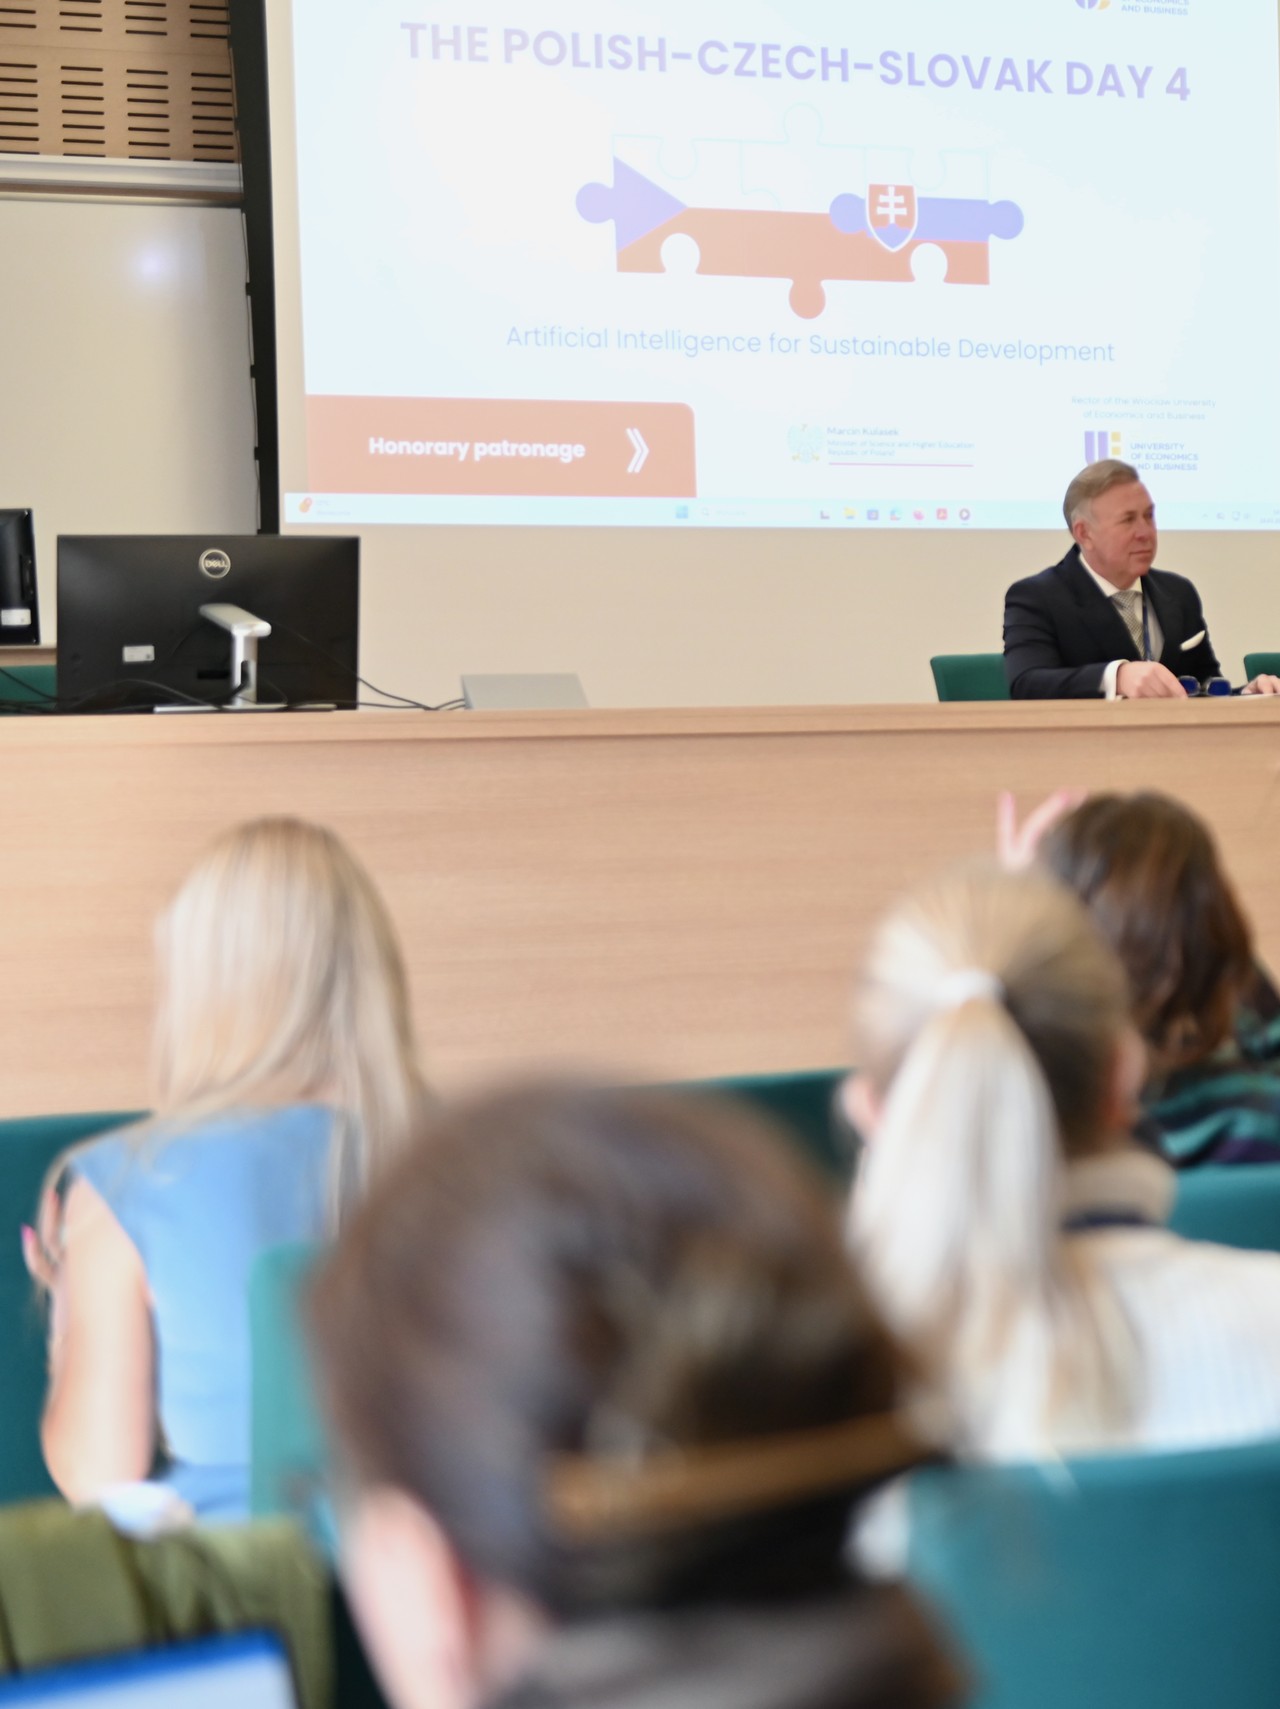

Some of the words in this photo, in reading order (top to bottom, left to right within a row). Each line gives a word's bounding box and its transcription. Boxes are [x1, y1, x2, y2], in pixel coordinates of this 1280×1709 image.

[400, 21, 490, 63] THE
[501, 27, 1053, 95] POLISH-CZECH-SLOVAK
[1065, 60, 1153, 99] DAY
[1165, 66, 1191, 101] 4
[506, 326, 609, 349] Artificial
[616, 329, 762, 358] Intelligence
[768, 333, 802, 354] for
[809, 334, 952, 358] Sustainable
[958, 337, 1115, 366] Development
[368, 437, 469, 462] Honorary
[473, 440, 586, 463] patronage
[1129, 442, 1185, 451] UNIVERSITY
[1129, 452, 1142, 462] OF
[1144, 453, 1199, 462] ECONOMICS
[1153, 463, 1198, 472] BUSINESS
[204, 558, 227, 569] DELL
